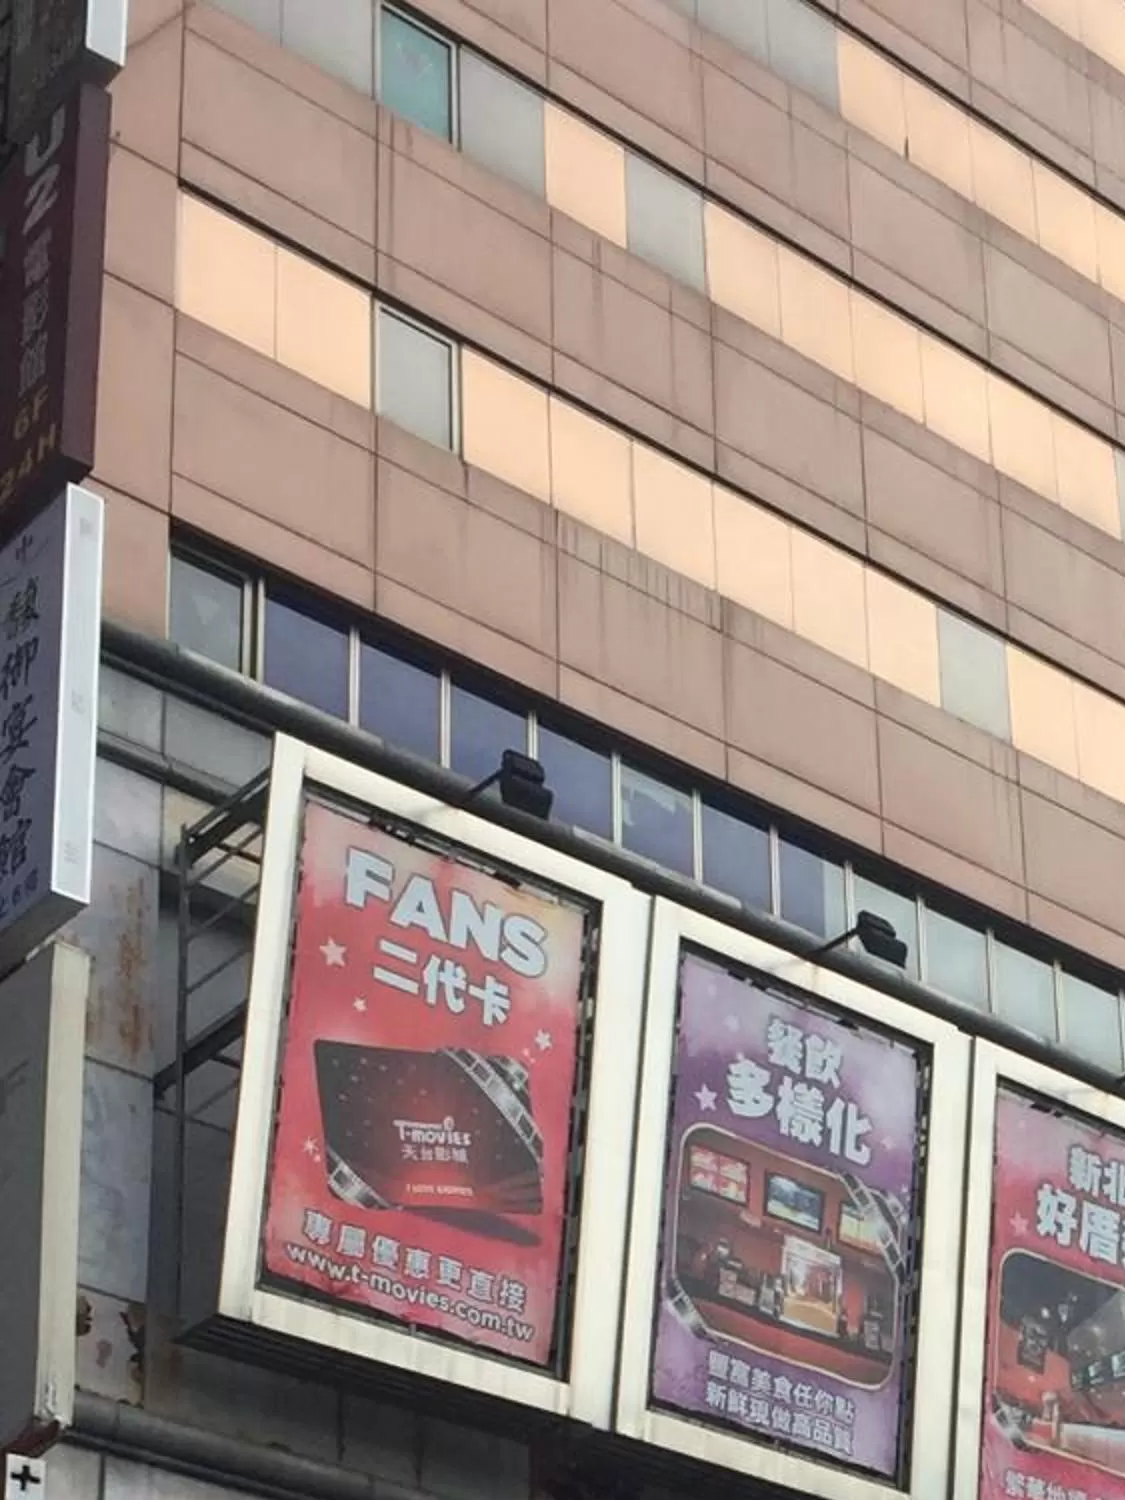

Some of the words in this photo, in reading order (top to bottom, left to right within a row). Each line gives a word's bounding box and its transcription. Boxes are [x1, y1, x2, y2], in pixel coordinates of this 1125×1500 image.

[344, 847, 547, 979] FANS
[373, 941, 511, 1028] 二代卡
[767, 1016, 844, 1089] 餐飲
[725, 1057, 873, 1169] 多樣化
[285, 1243, 535, 1342] www.t-movies.com.tw
[303, 1209, 529, 1314] 專屬優惠更直接
